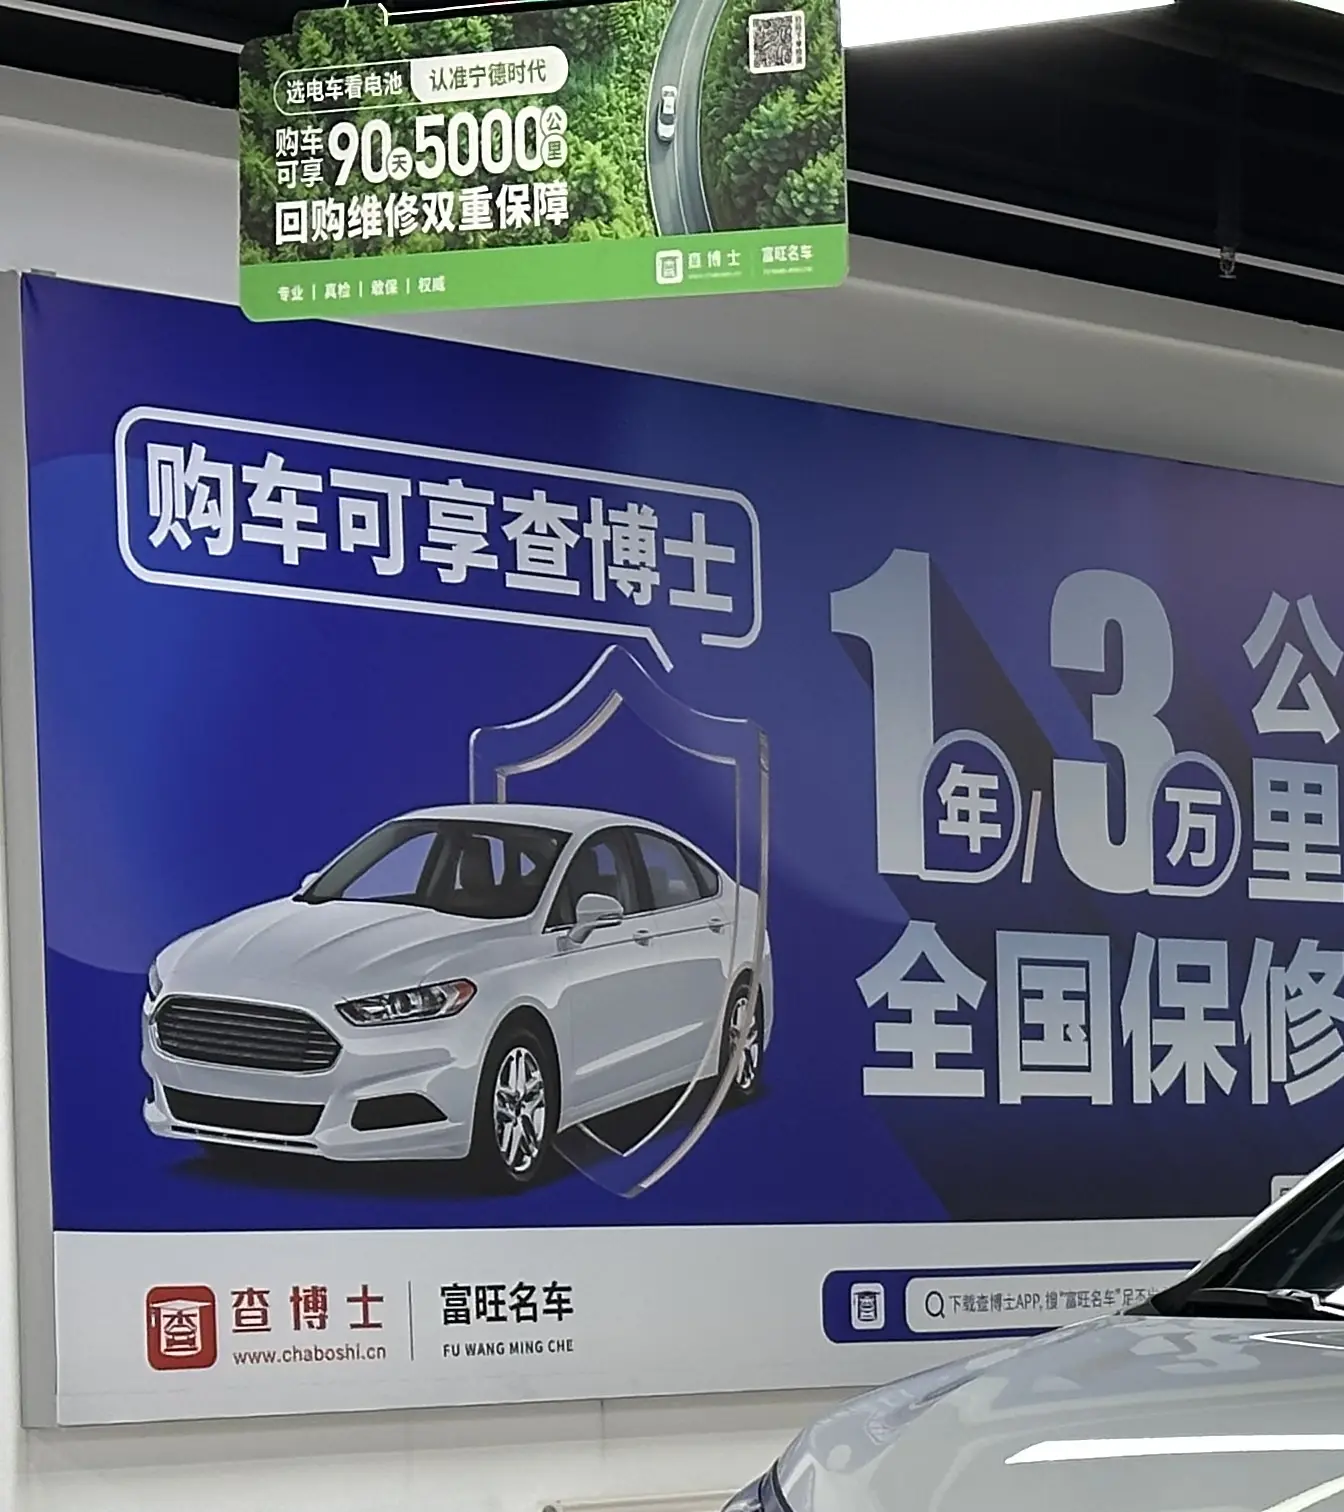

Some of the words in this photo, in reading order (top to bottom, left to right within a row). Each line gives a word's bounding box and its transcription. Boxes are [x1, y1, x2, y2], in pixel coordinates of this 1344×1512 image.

[285, 71, 403, 104] 选电车看电池
[429, 58, 546, 92] 认准宁德时代
[275, 126, 324, 158] 购车
[276, 157, 324, 189] 可享
[275, 182, 569, 245] 回购维修双重保障
[146, 442, 738, 613] 购车可享查博士
[230, 1283, 386, 1334] 查博士
[440, 1280, 574, 1327] 富旺名车
[232, 1343, 387, 1366] www.chaboshi.cn
[443, 1343, 462, 1358] FU
[466, 1341, 506, 1358] WANG
[509, 1340, 545, 1356] MING
[547, 1338, 574, 1355] CHE
